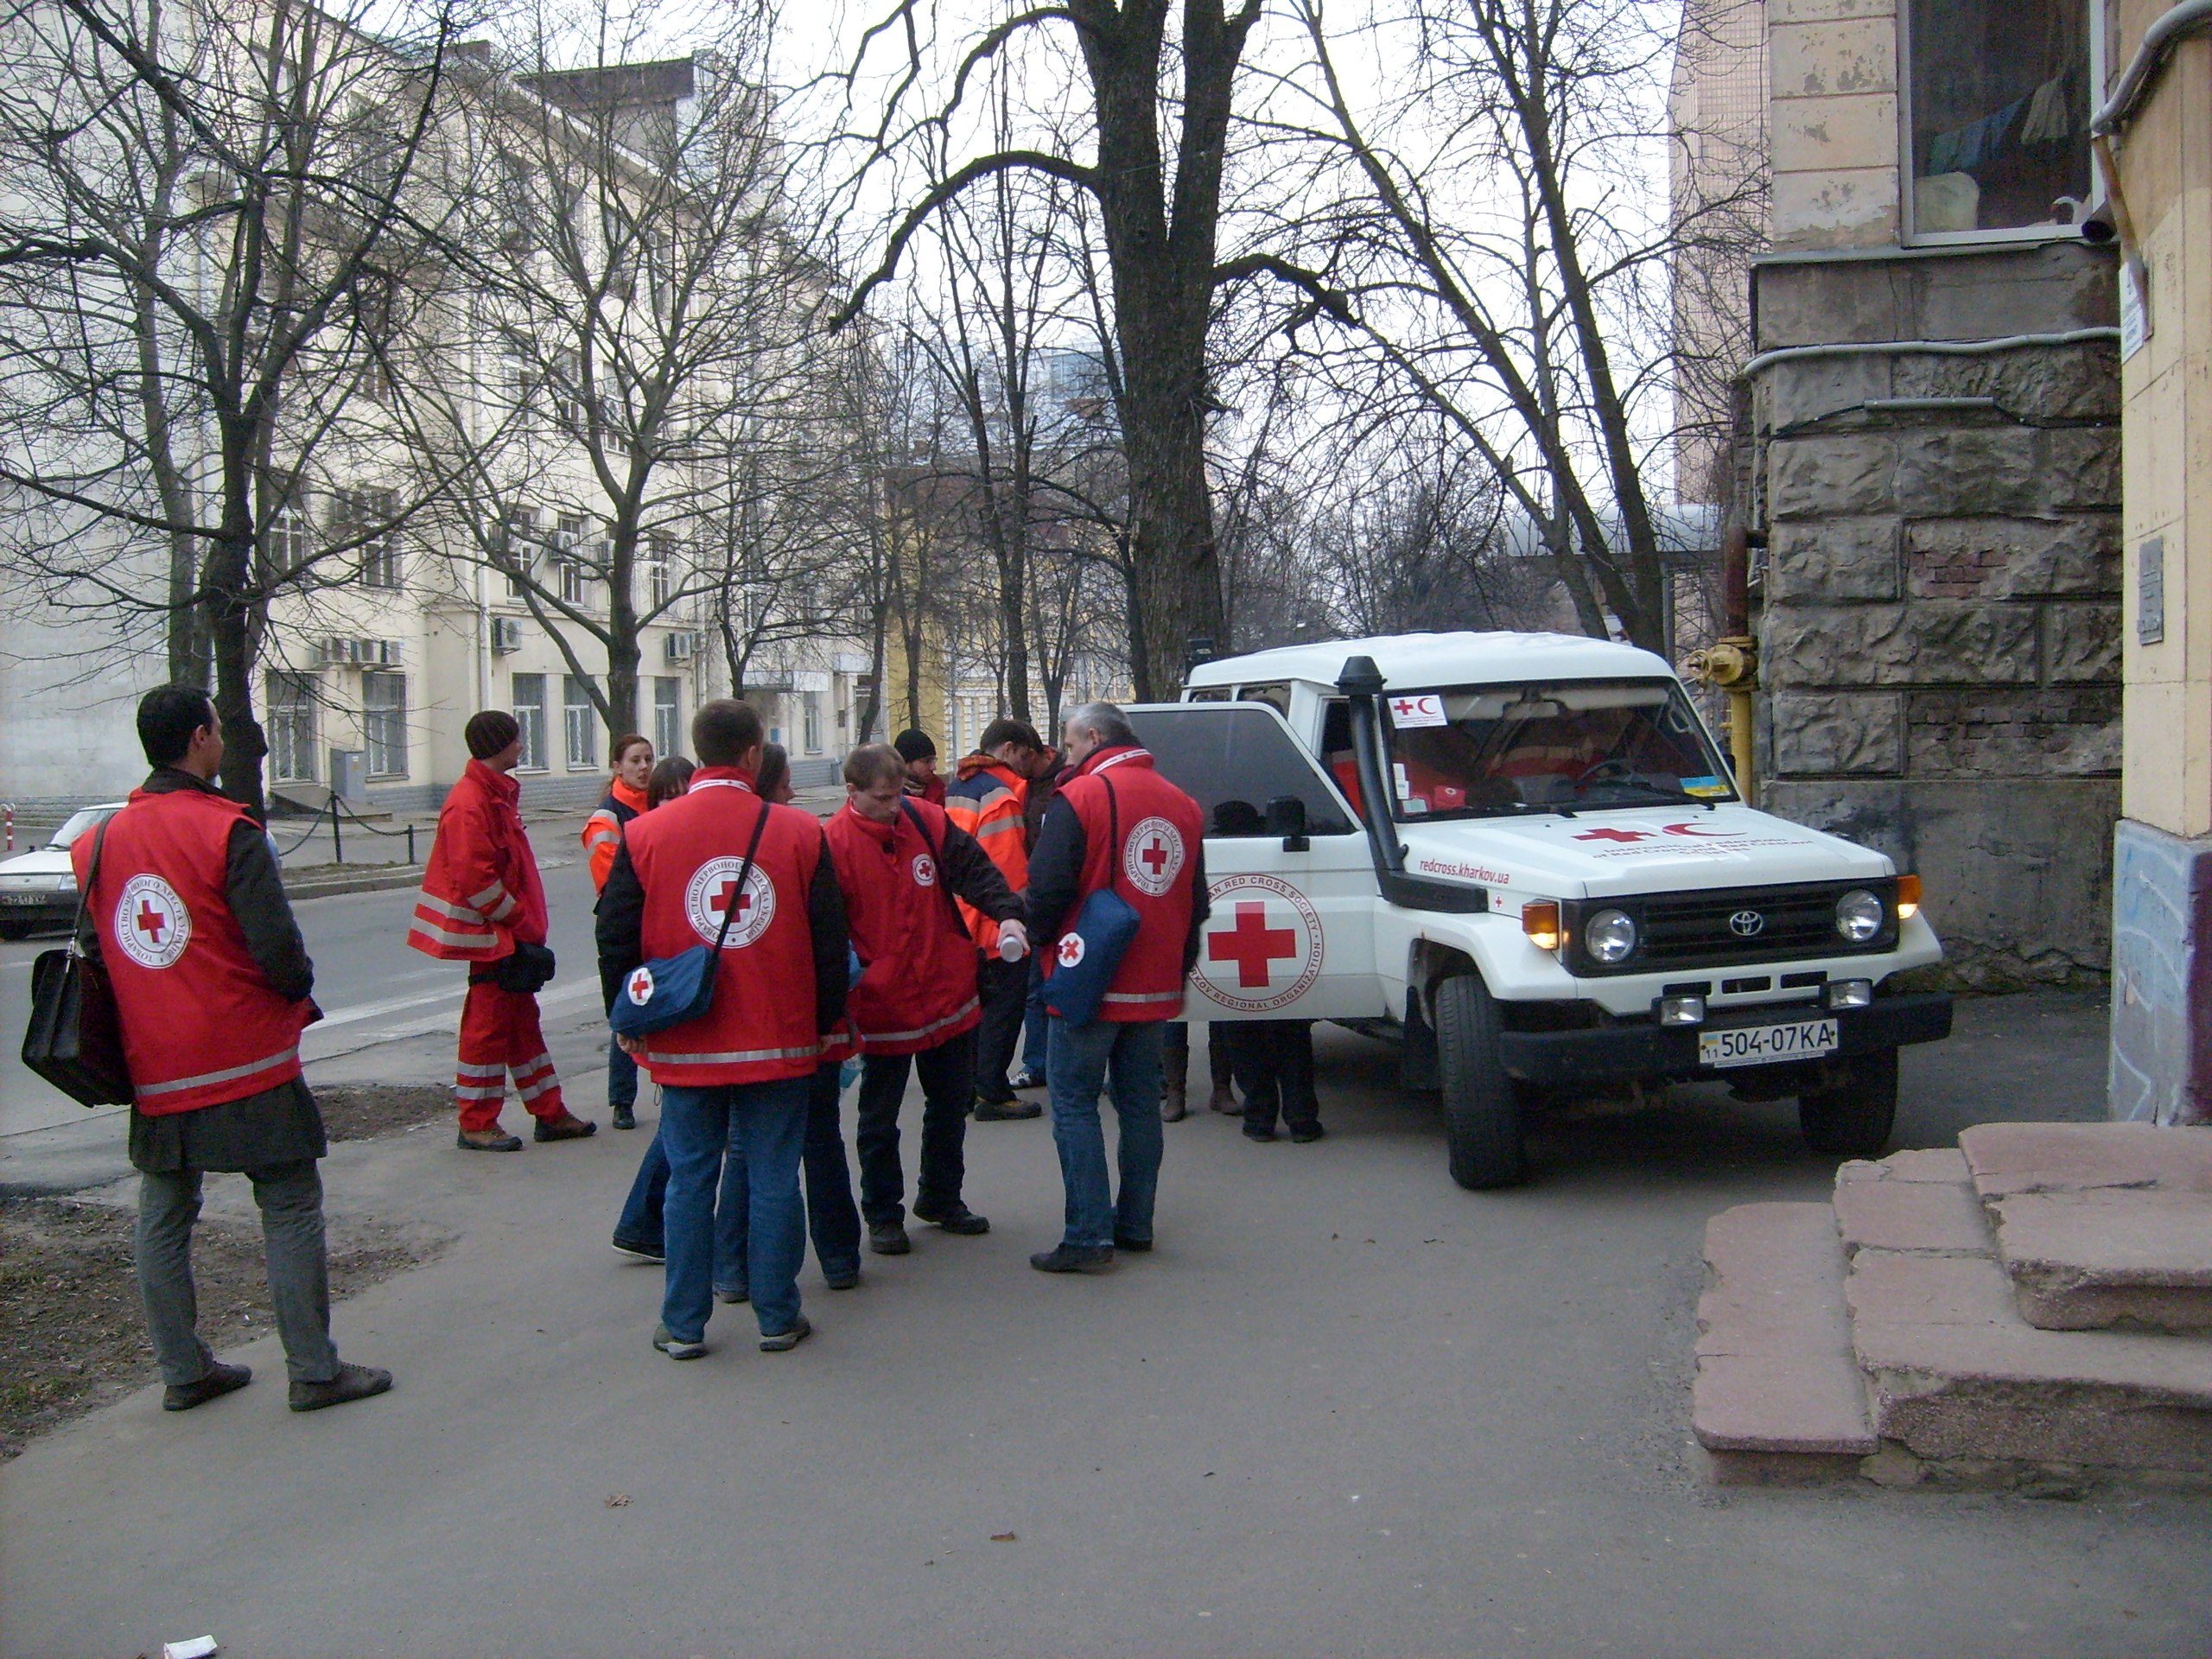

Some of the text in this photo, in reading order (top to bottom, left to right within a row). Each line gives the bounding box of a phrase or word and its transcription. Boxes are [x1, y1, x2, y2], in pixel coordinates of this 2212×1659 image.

[696, 861, 743, 887] ЧЕРВОНОГ
[1420, 859, 1510, 884] redcross.kharkov.ua
[691, 888, 719, 939] ОВАРИСТВО
[1224, 877, 1319, 931] RED CROSS SOCIETY
[1191, 943, 1320, 1009] RKOV REGIONAL ORGANIZATION
[1706, 1048, 1718, 1058] 11
[1721, 1022, 1833, 1058] 504-07KA
